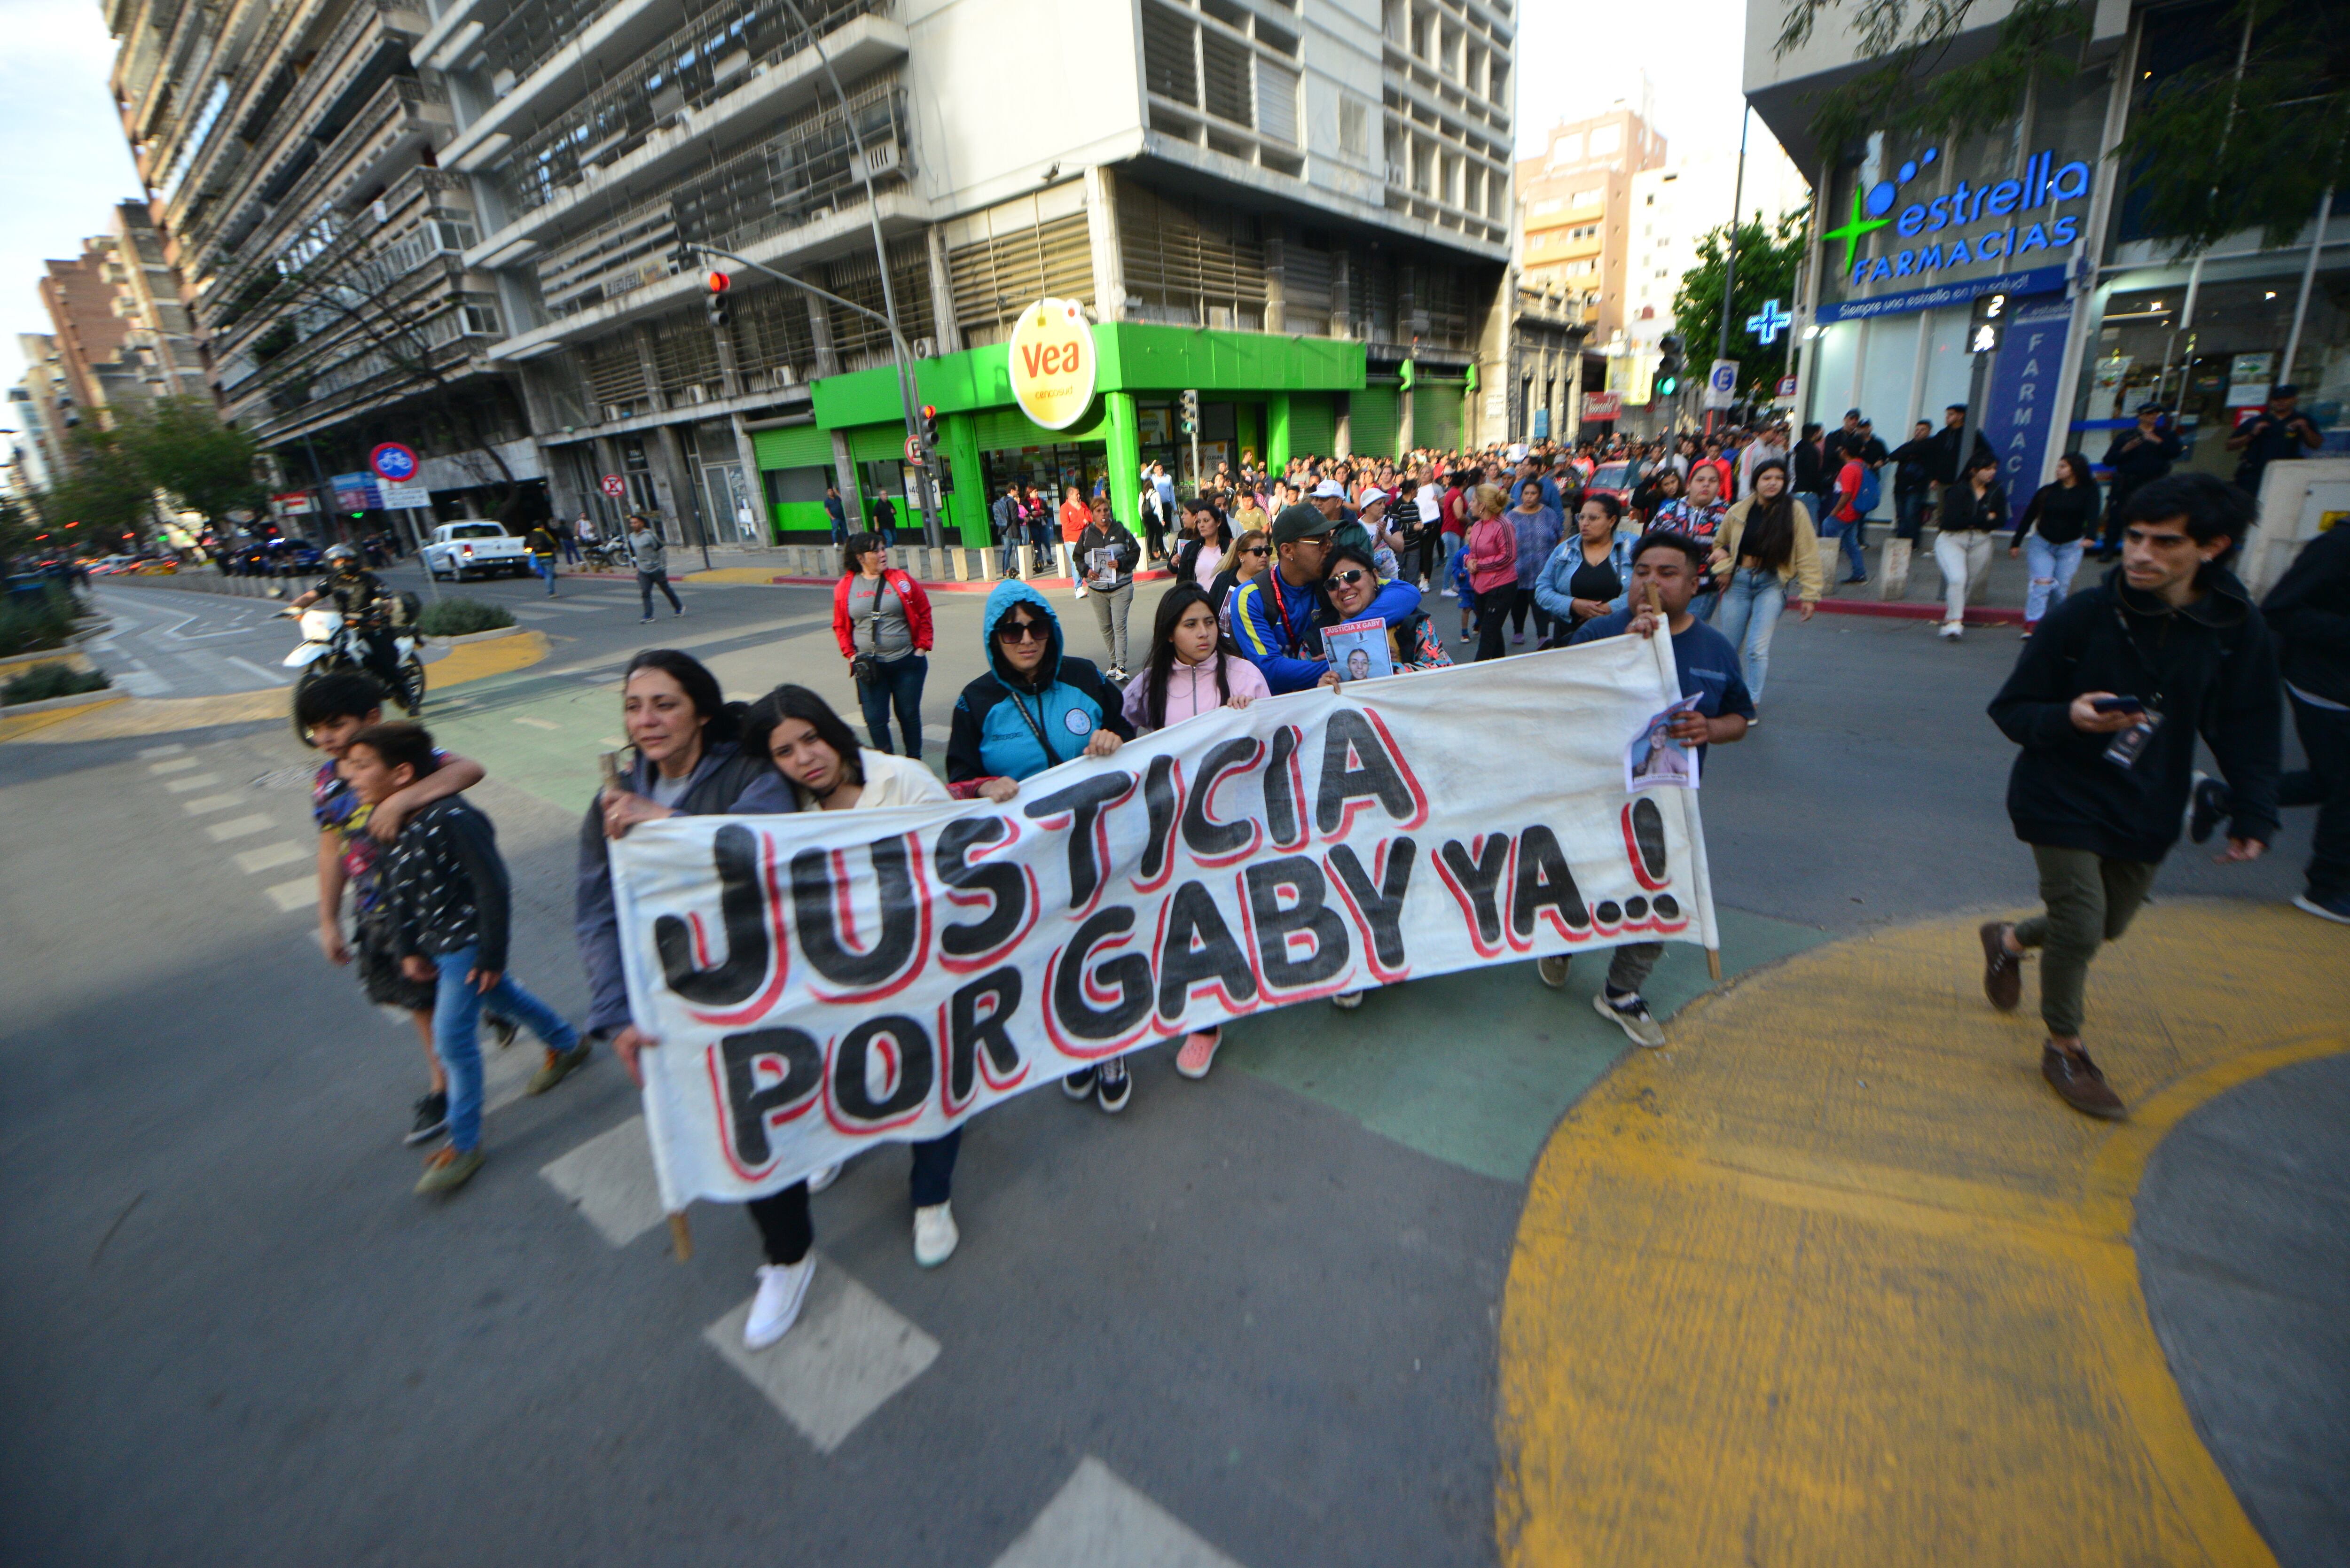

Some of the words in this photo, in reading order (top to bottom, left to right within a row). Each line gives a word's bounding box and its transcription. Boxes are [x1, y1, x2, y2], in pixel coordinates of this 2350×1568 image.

[1897, 149, 2090, 238] estrella
[1853, 216, 2078, 287] FARMACIAS
[1838, 303, 1882, 320] Siempre
[1905, 288, 1950, 309] estrella
[1987, 295, 2005, 319] 2
[1021, 341, 1079, 378] Vea
[1035, 385, 1073, 399] cencosud
[1717, 368, 1732, 389] E
[1780, 378, 1795, 395] E
[1327, 624, 1355, 634] JUSTICIA
[1363, 620, 1380, 628] GABY
[655, 708, 1428, 1025] JUSTICIA
[706, 966, 1031, 1182] POR
[1042, 836, 1417, 1059] GABY
